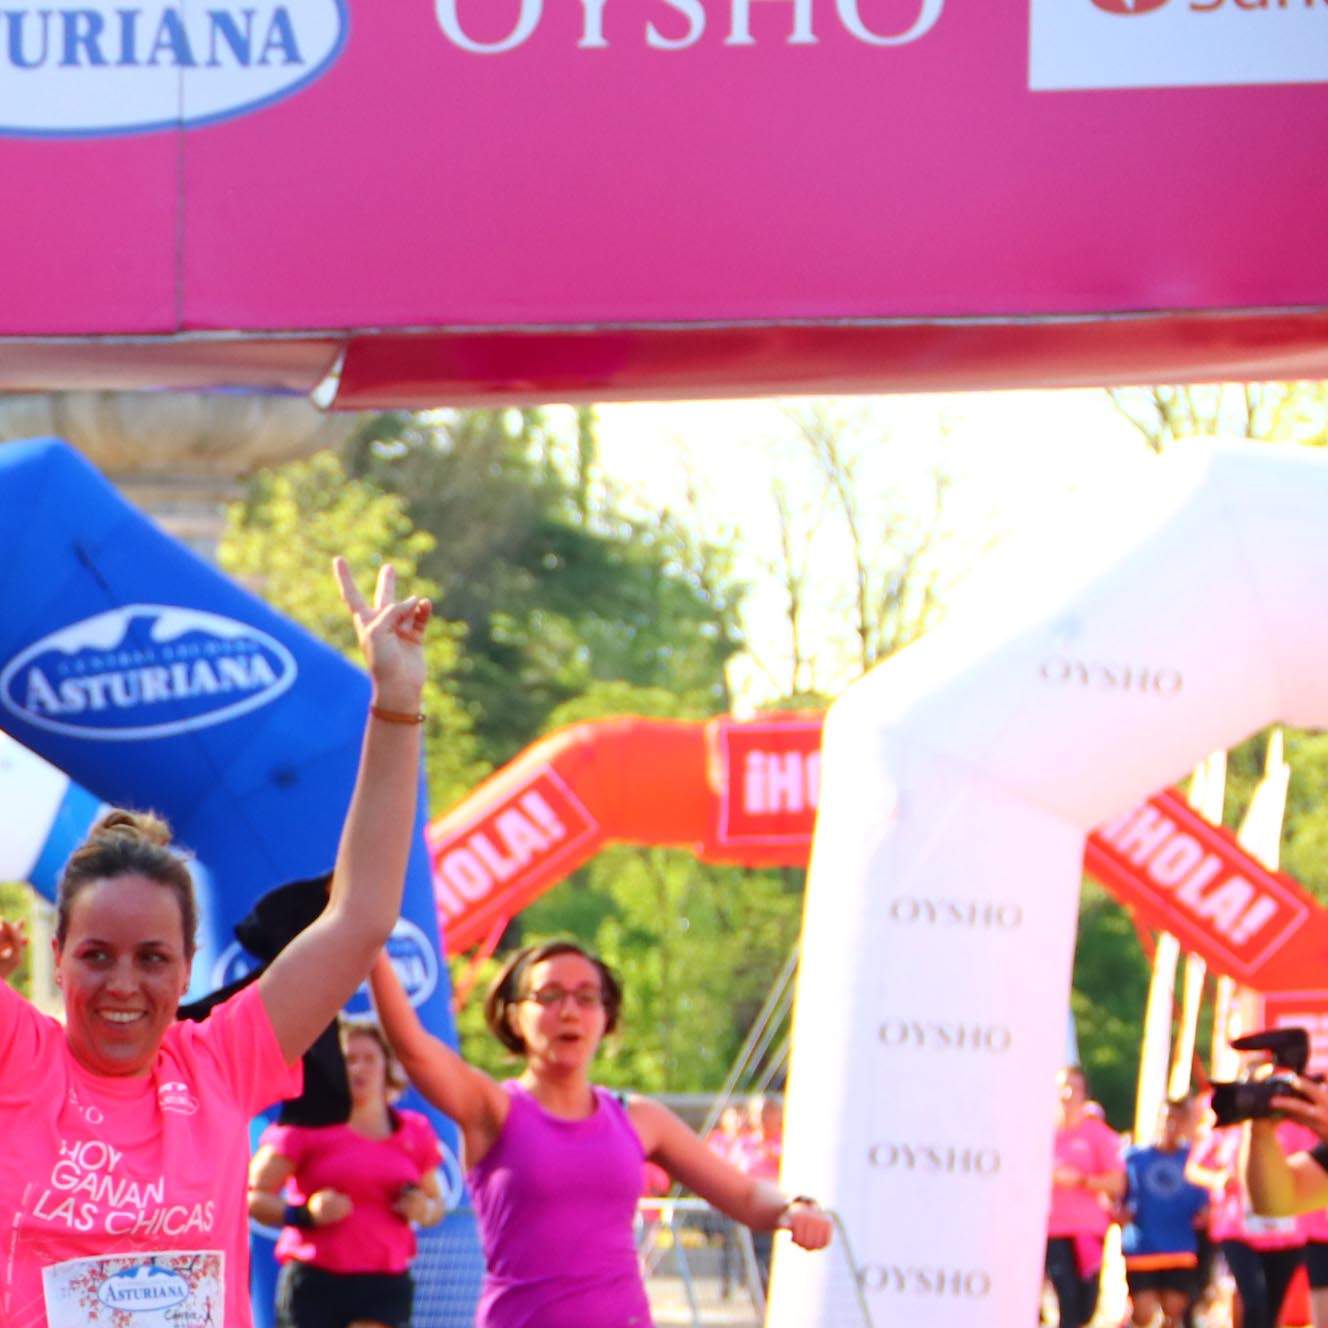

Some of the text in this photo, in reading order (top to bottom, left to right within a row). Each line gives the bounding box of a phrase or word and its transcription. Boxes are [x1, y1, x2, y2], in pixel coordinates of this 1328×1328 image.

[26, 654, 278, 714] ASTURIANA
[878, 1021, 1012, 1055] OYSHO
[59, 1139, 124, 1173] HOY
[867, 1143, 1002, 1177] OYSHO
[51, 1160, 166, 1209] GANAN
[33, 1189, 216, 1236] LAS CHICAS
[105, 1285, 184, 1301] ASTURIANA
